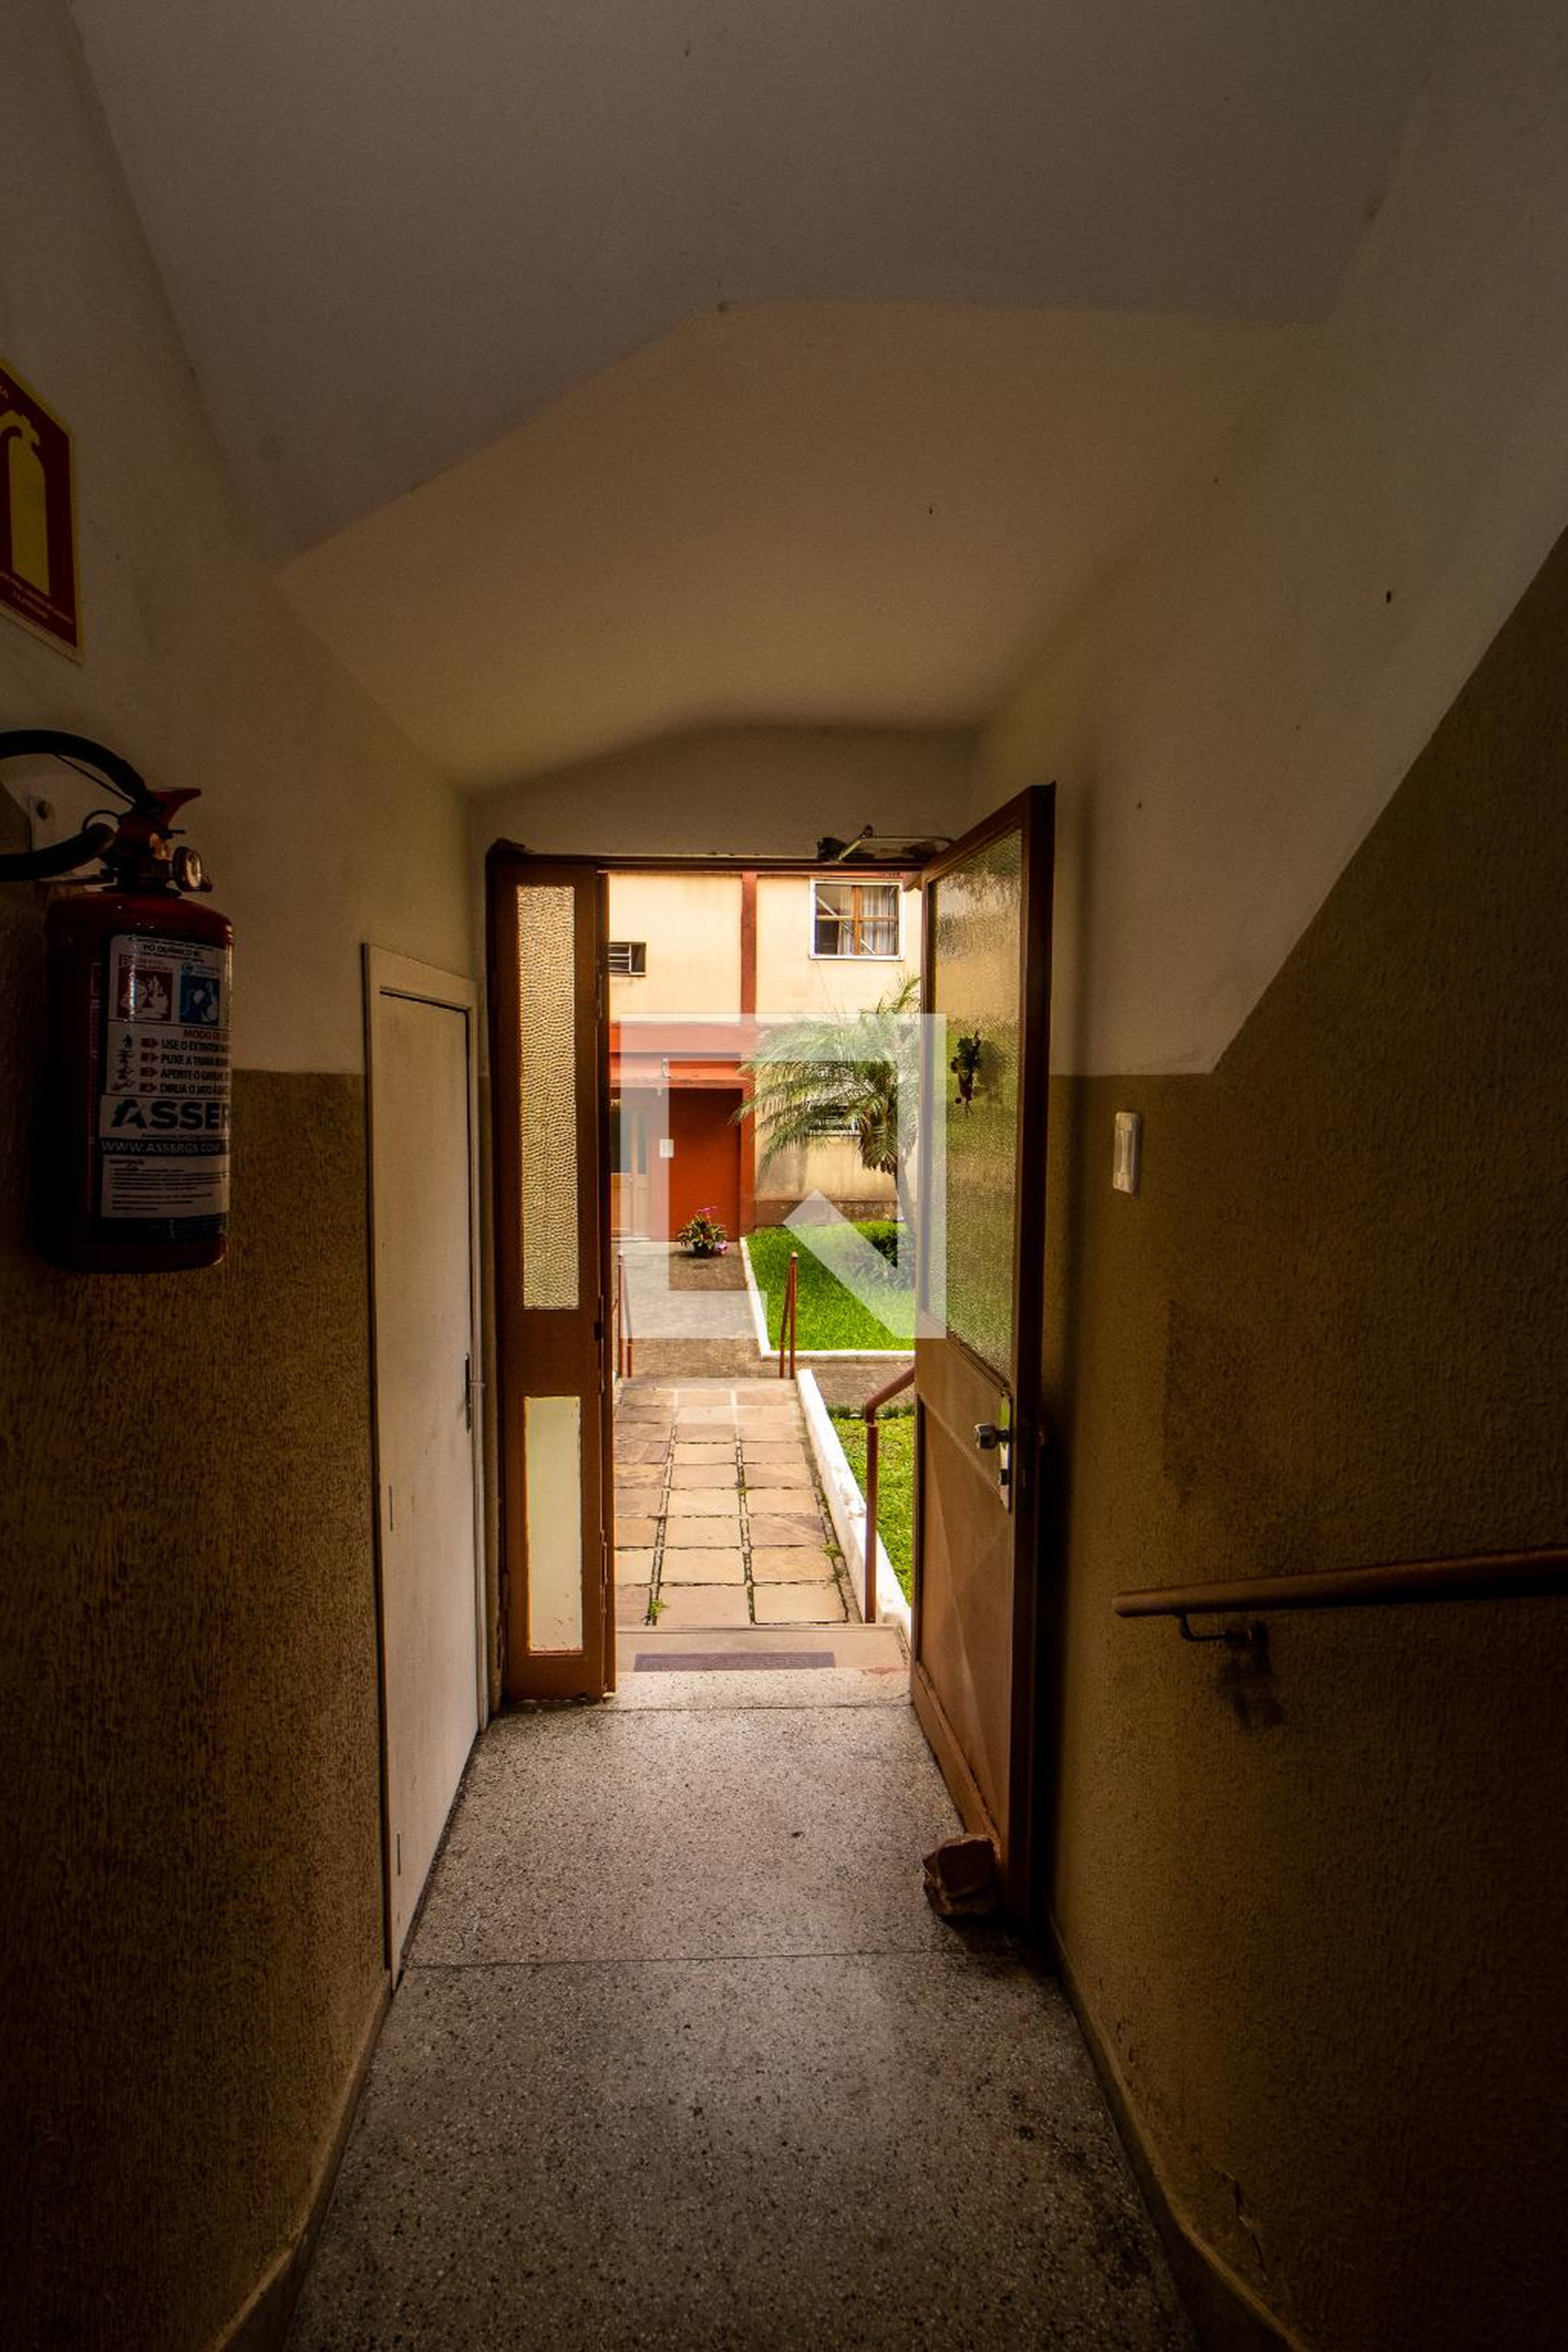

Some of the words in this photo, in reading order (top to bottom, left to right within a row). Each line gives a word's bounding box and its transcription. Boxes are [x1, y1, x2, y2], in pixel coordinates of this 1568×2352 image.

[184, 1029, 211, 1039] MODO
[162, 1038, 179, 1050] USE
[180, 1042, 187, 1050] O
[161, 1054, 184, 1065] PUXE
[186, 1056, 192, 1066] A
[160, 1069, 192, 1079] APERTE
[194, 1071, 200, 1080] O
[189, 1084, 195, 1094] O
